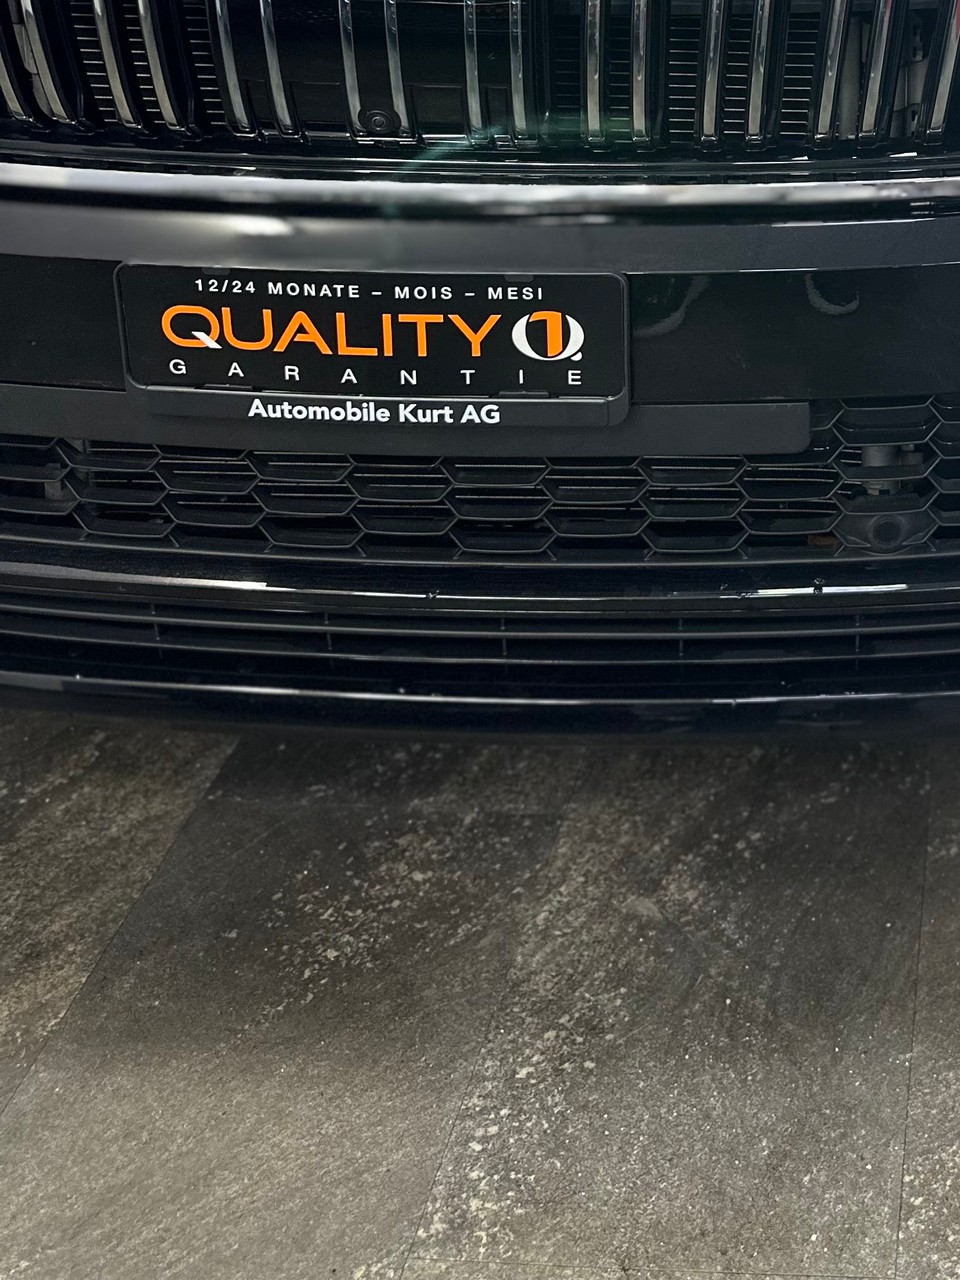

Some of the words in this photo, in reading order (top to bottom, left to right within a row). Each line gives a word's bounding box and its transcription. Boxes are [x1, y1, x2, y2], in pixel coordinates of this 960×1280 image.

[195, 278, 256, 294] 12/24
[268, 281, 360, 298] MONATE
[394, 285, 453, 300] MOIS
[487, 286, 543, 300] MESI
[161, 304, 502, 357] QUALITY
[170, 359, 582, 385] GARANTIE
[248, 398, 391, 423] Automobile
[398, 401, 454, 424] Kurt
[460, 404, 501, 424] AG
